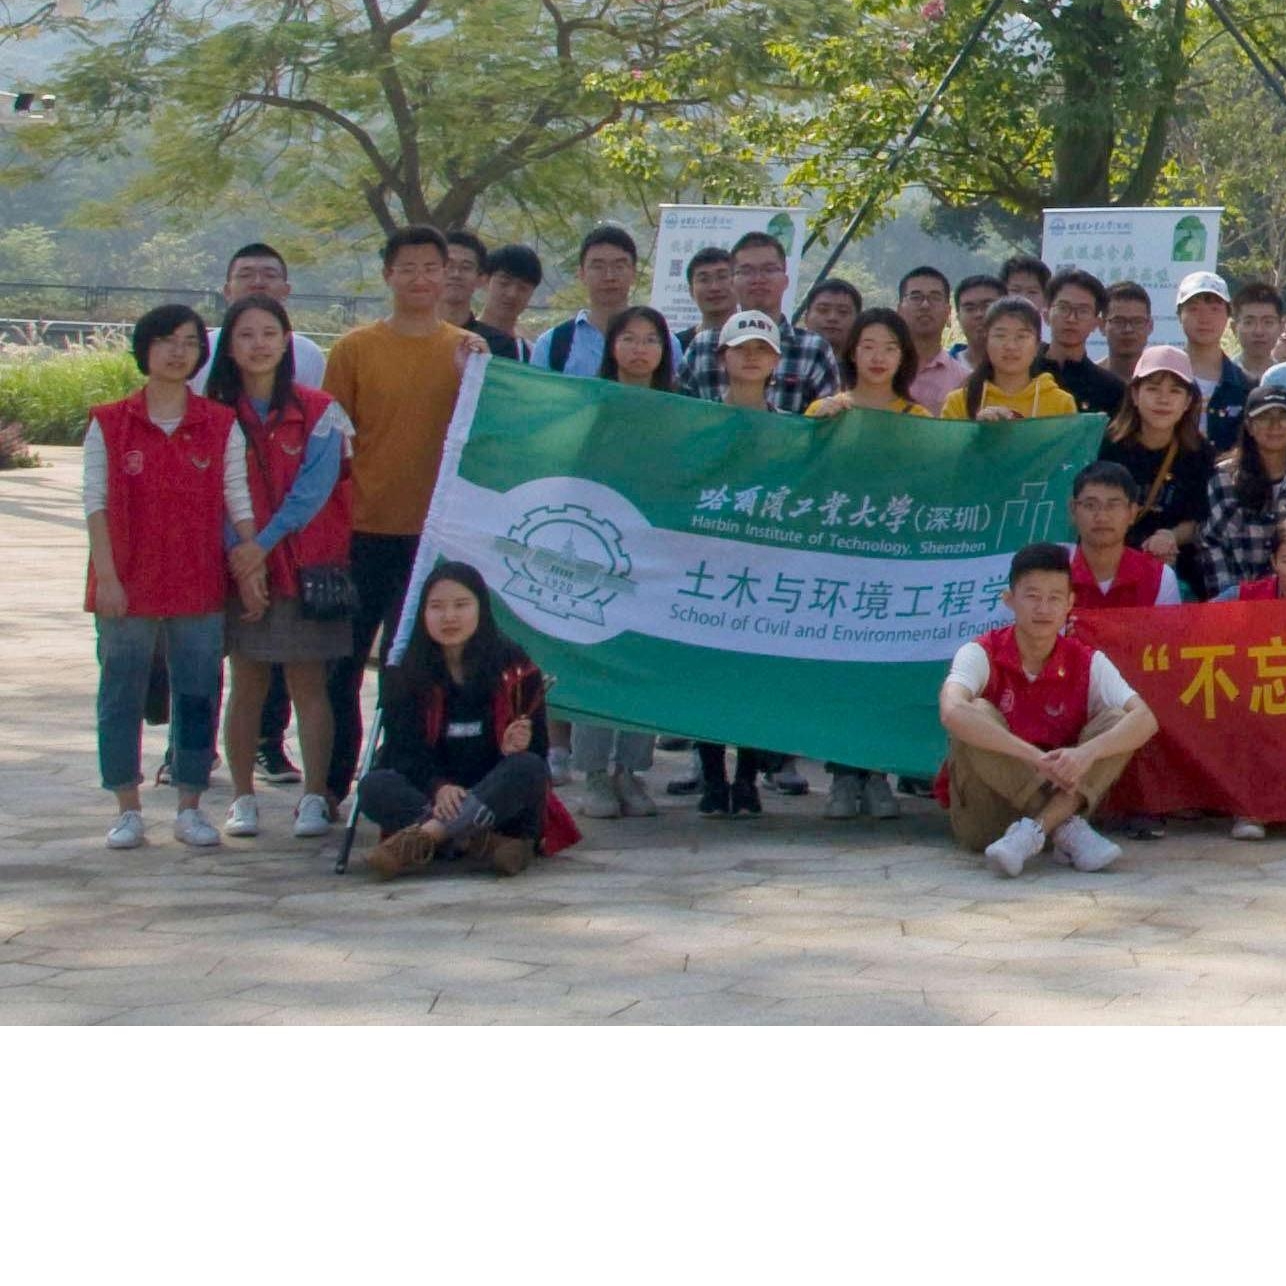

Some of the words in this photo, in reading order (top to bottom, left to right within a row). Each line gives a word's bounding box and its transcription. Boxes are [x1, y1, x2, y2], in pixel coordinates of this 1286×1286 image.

[738, 319, 773, 332] BABY
[691, 513, 740, 533] Harbin
[745, 522, 803, 544] Institute
[808, 531, 825, 545] of
[919, 540, 987, 555] Shenzhen
[528, 583, 578, 608] HIT
[669, 603, 726, 627] School
[731, 615, 749, 632] of
[754, 616, 791, 637] Civil
[794, 623, 827, 640] and
[832, 622, 953, 643] Environmental
